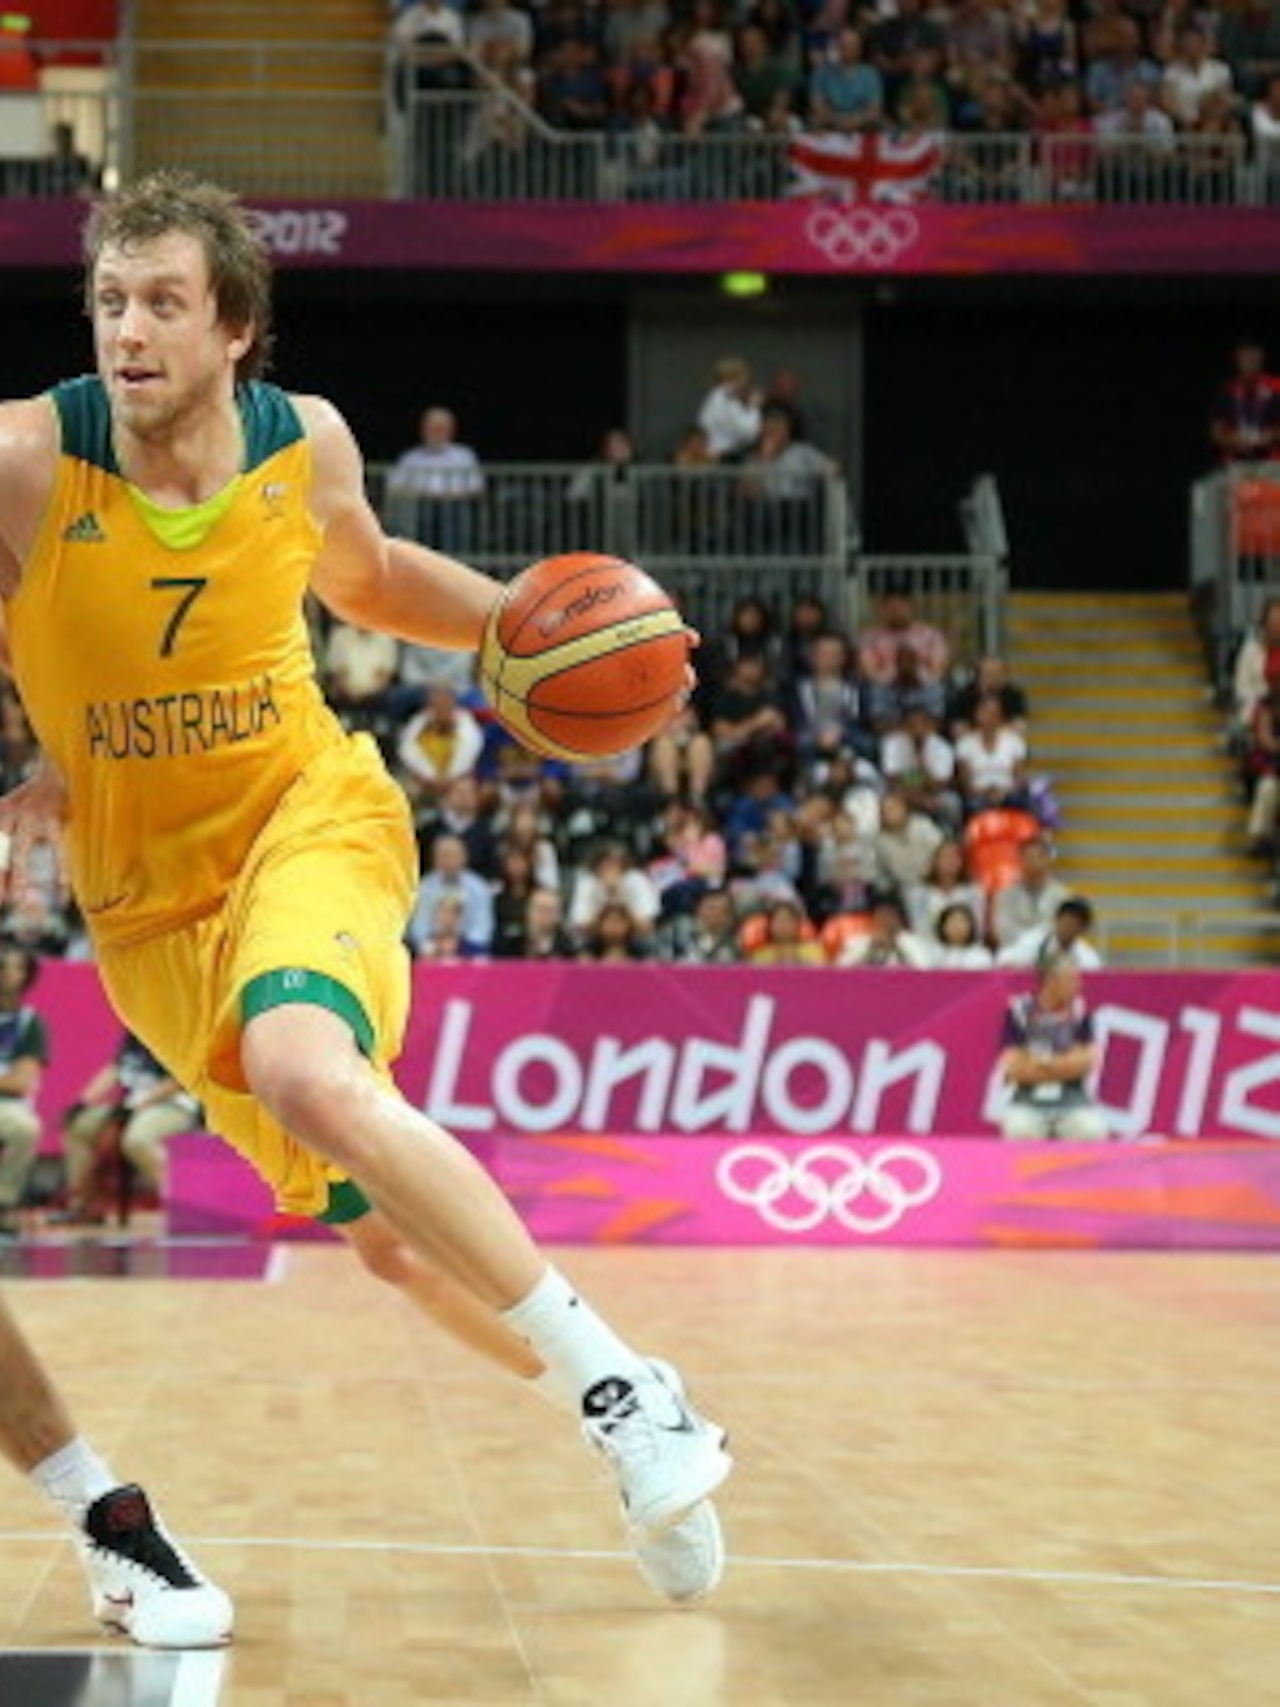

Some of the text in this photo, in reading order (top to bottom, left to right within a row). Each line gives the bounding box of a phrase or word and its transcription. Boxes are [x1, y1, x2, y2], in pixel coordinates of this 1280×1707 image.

[150, 576, 208, 658] 7
[85, 676, 280, 760] AUSTRALIA
[424, 993, 946, 1134] London
